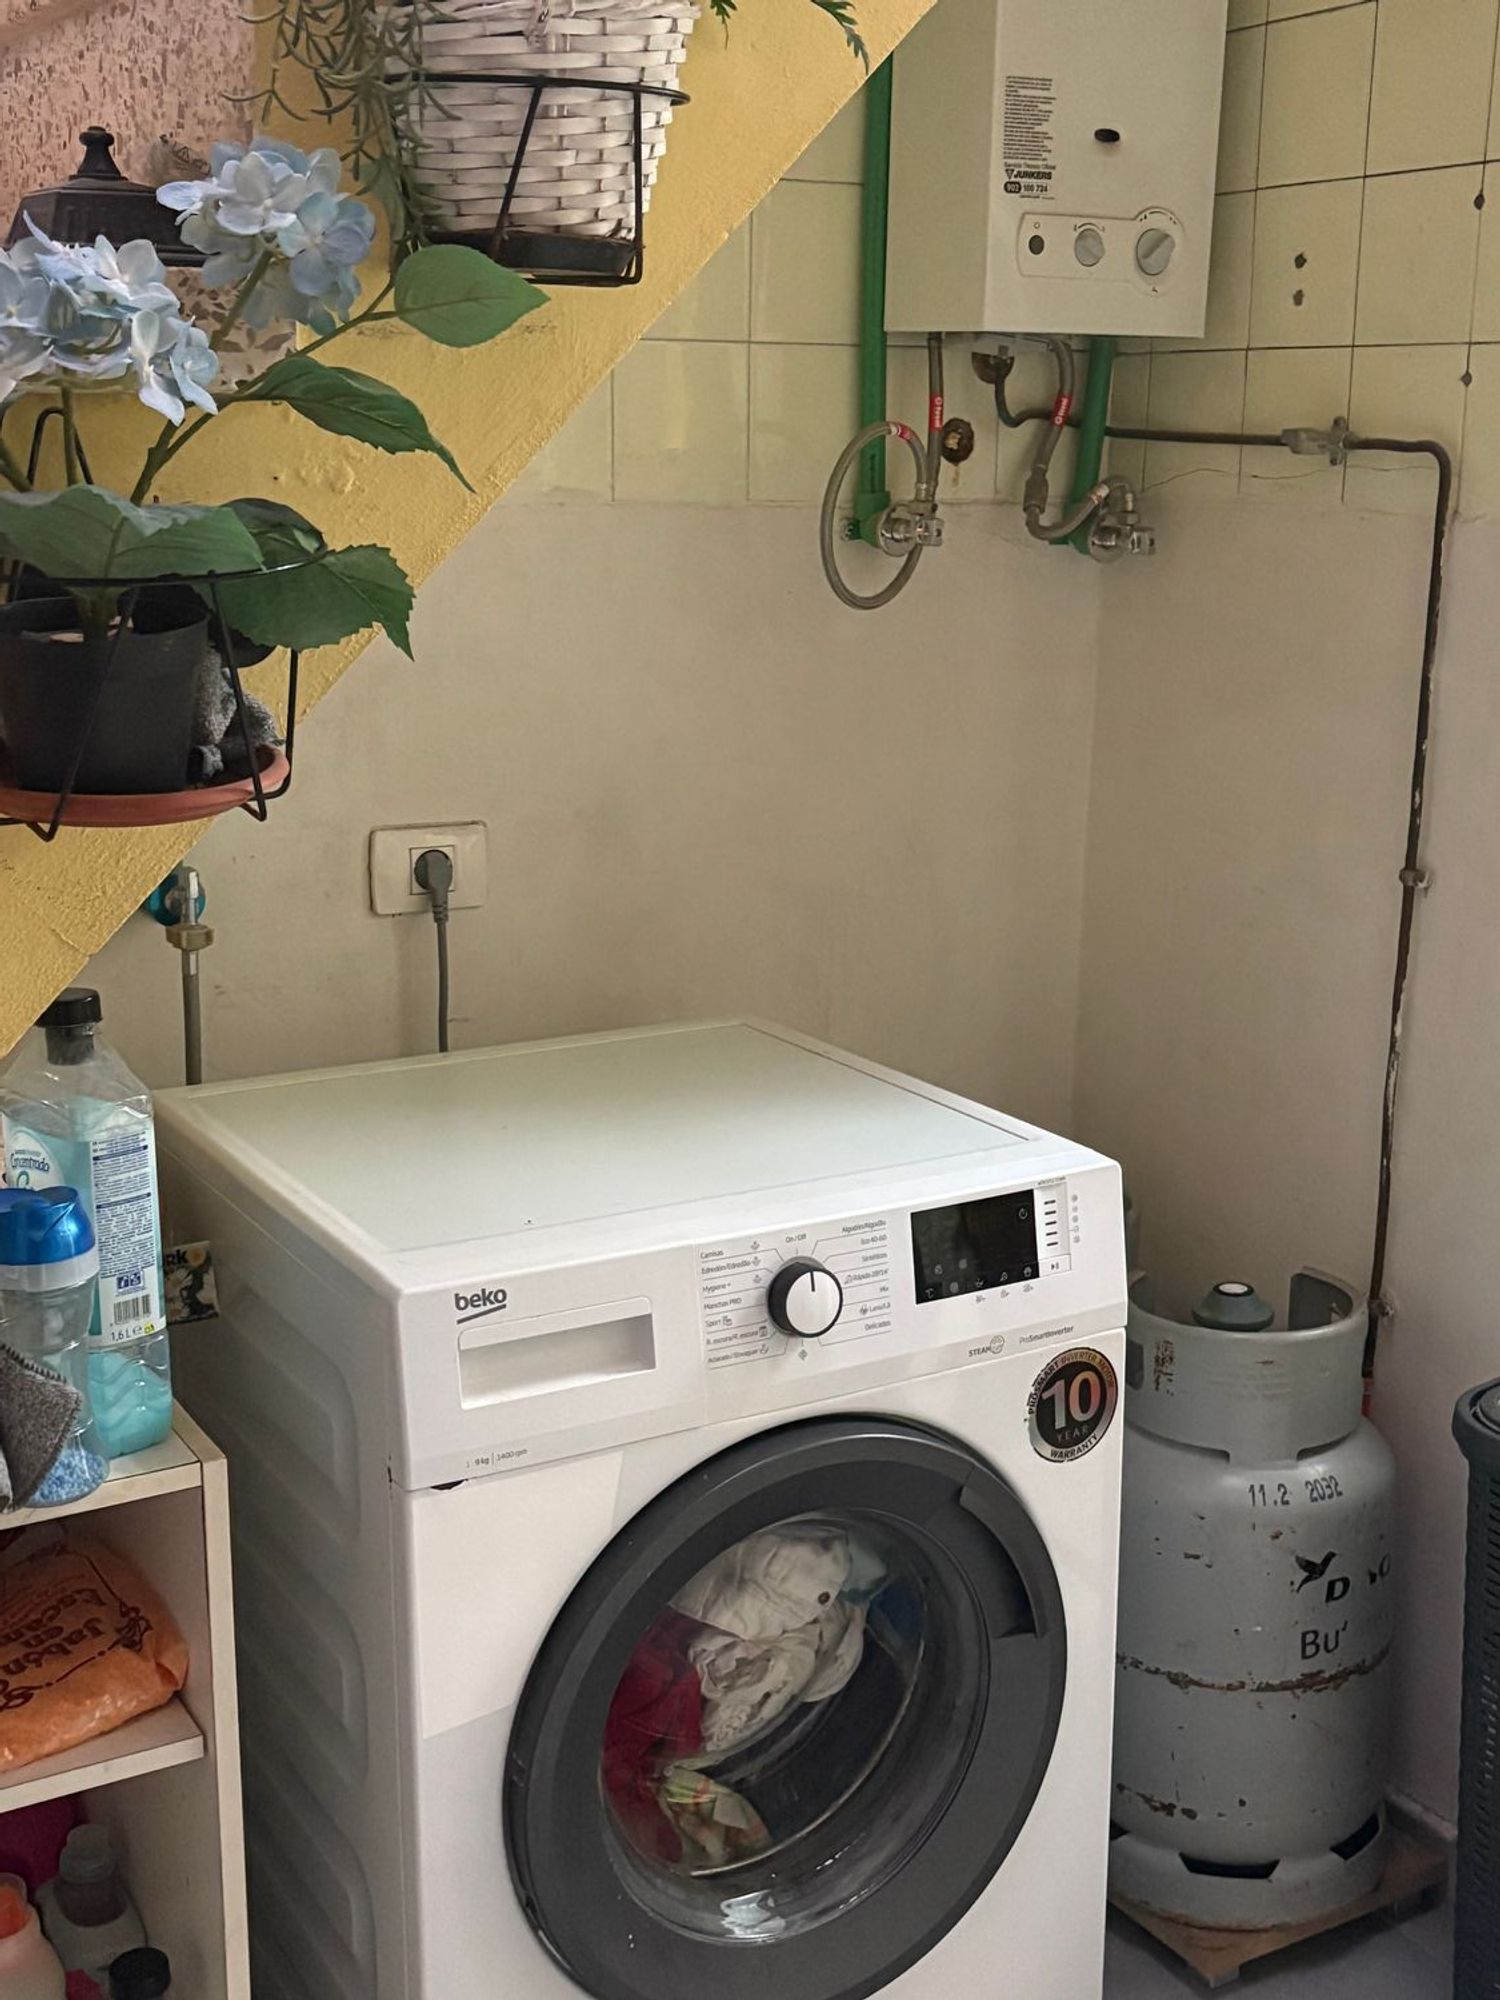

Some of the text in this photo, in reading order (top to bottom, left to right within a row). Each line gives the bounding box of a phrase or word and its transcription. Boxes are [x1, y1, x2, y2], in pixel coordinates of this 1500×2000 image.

[1014, 170, 1052, 180] JUNKERS
[454, 1288, 507, 1311] beko
[1041, 1371, 1101, 1431] 10
[1050, 1432, 1098, 1459] WARRANTY
[1056, 1425, 1090, 1442] YEAR
[1305, 1475, 1344, 1504] 2032
